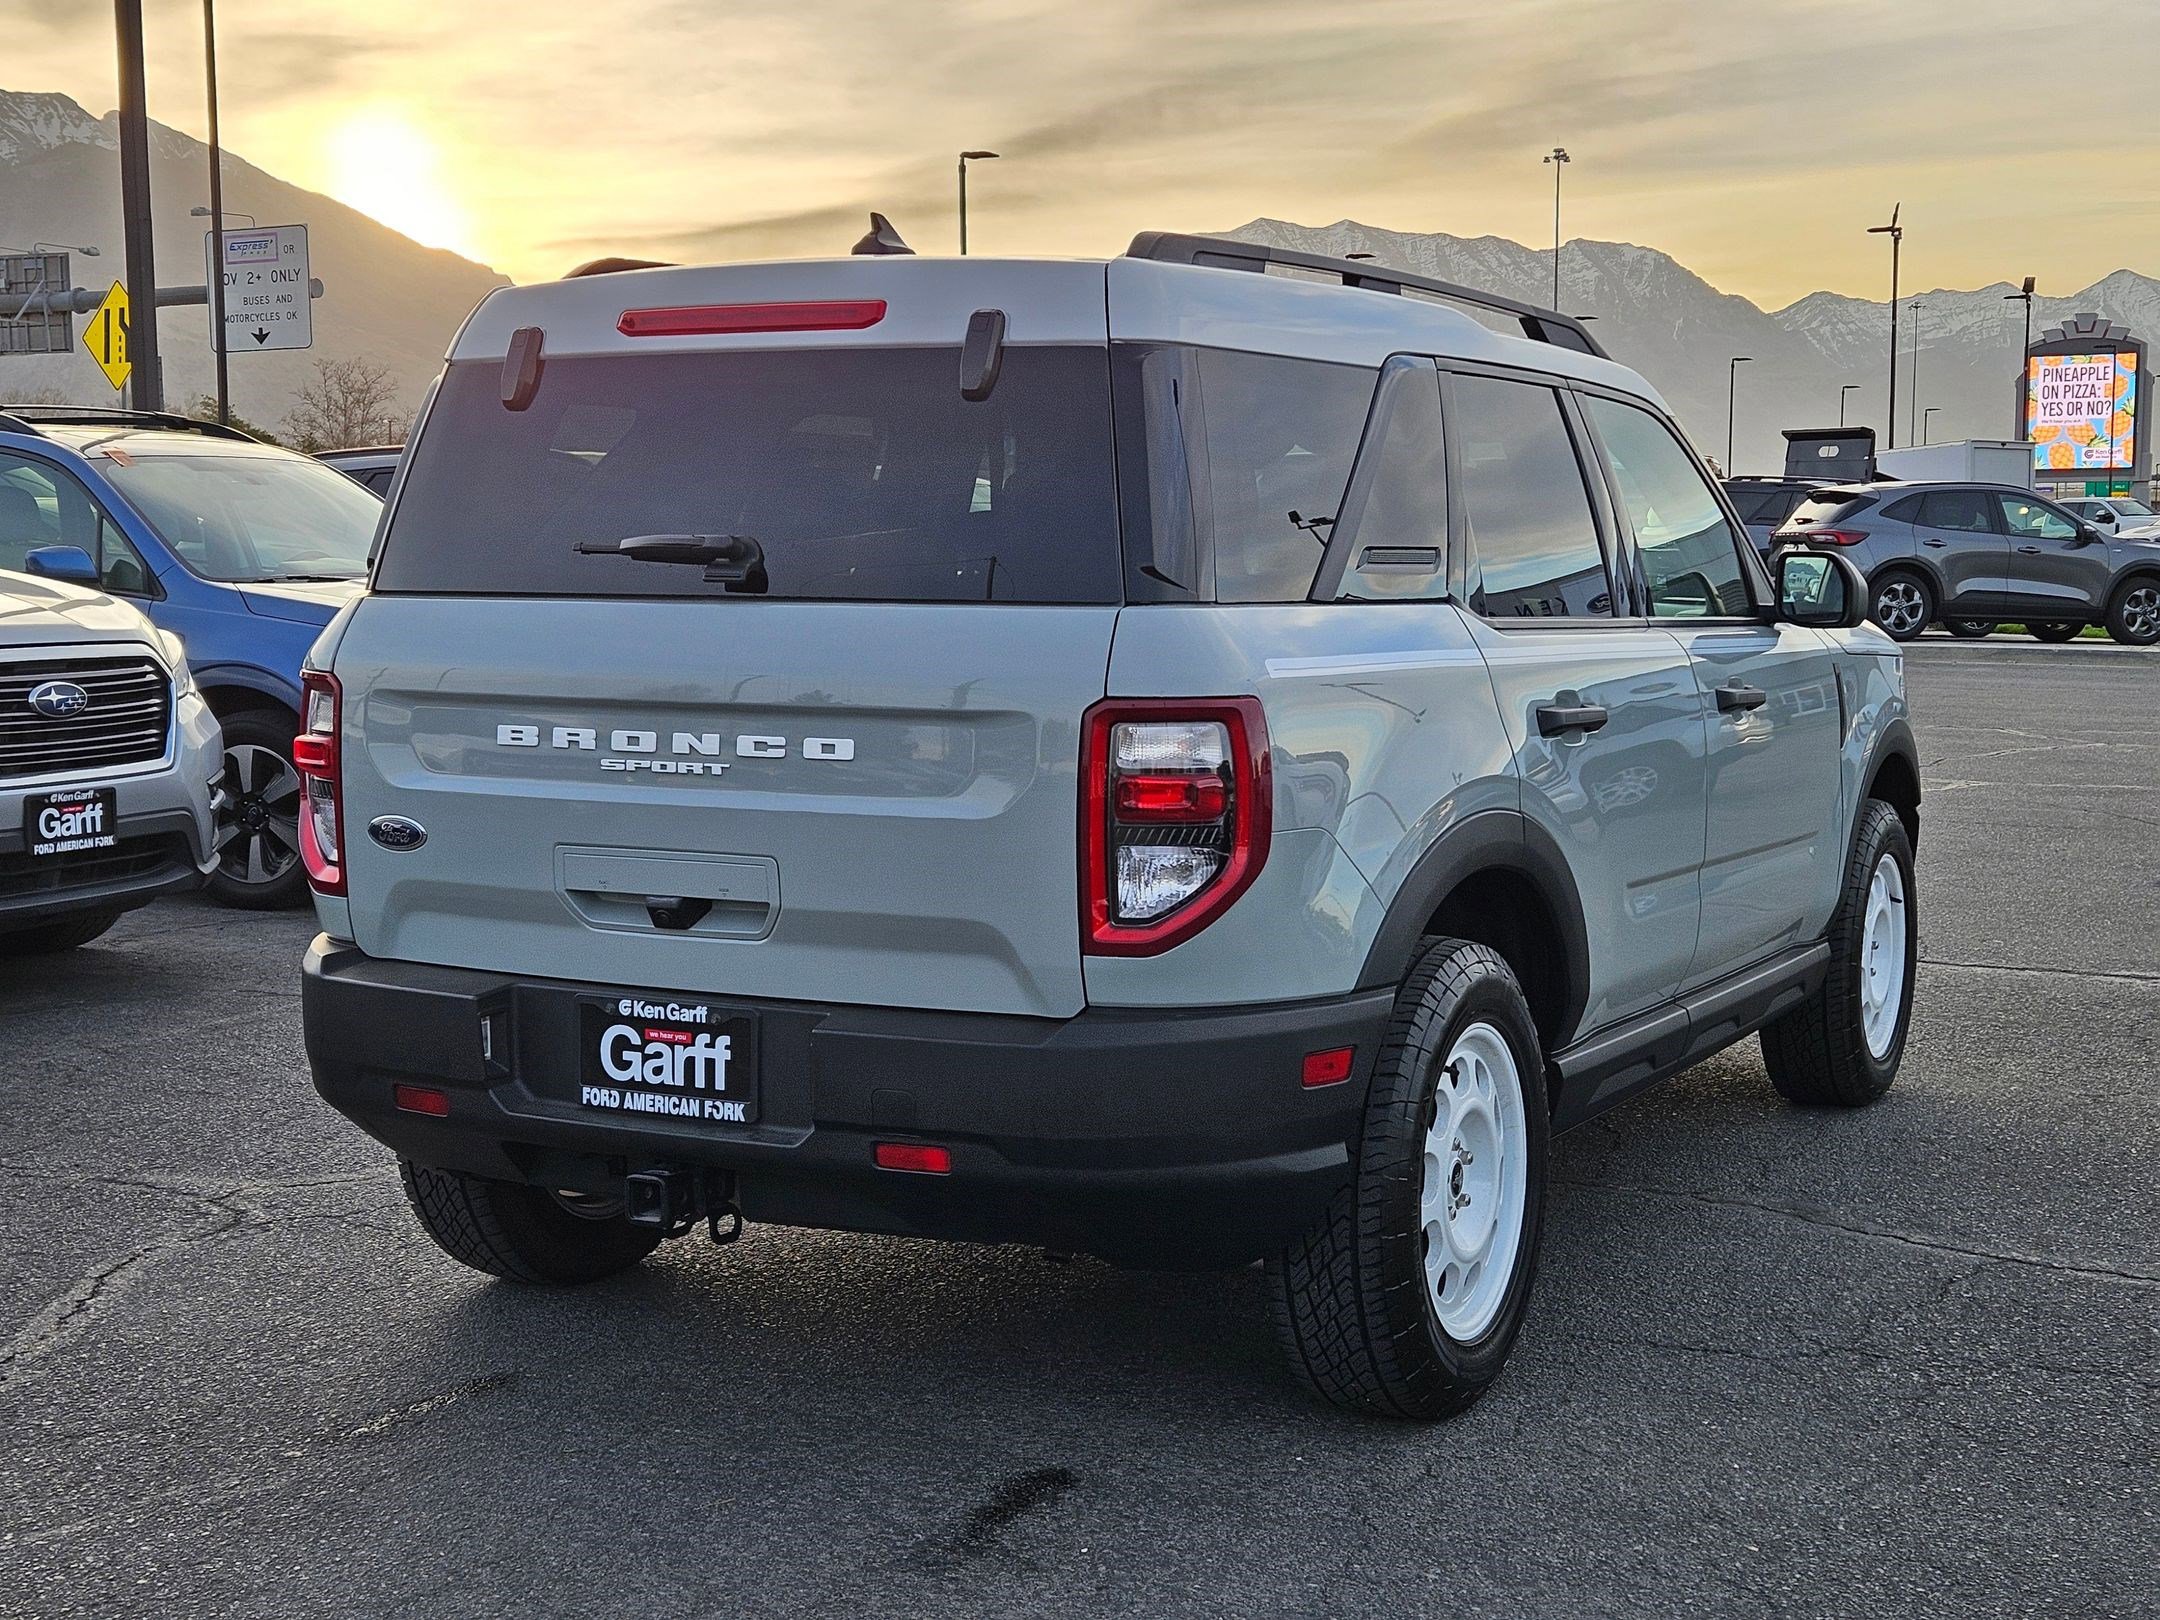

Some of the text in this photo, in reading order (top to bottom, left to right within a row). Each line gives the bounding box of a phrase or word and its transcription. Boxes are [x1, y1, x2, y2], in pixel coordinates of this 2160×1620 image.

[229, 241, 269, 254] Express
[283, 244, 295, 254] OR
[223, 268, 301, 286] OV 2+ ONLY
[243, 293, 293, 306] BUSES AND
[286, 310, 298, 320] OK
[2042, 366, 2111, 383] PINEAPPLE
[2042, 384, 2101, 400] ON PIZZA:
[2041, 400, 2112, 417] YES OR NO?
[496, 724, 855, 761] BRONCO
[600, 758, 731, 776] SPORT
[57, 790, 95, 803] Ken Garff
[38, 802, 104, 839] Garff
[379, 821, 411, 844] Ford
[33, 835, 115, 856] FORD AMERICAN FORK
[633, 1000, 708, 1024] Ken Garff
[660, 1031, 674, 1039] hear
[675, 1033, 687, 1041] you
[600, 1024, 731, 1091] Garff
[582, 1086, 746, 1122] FORD AMERICAN FORK
